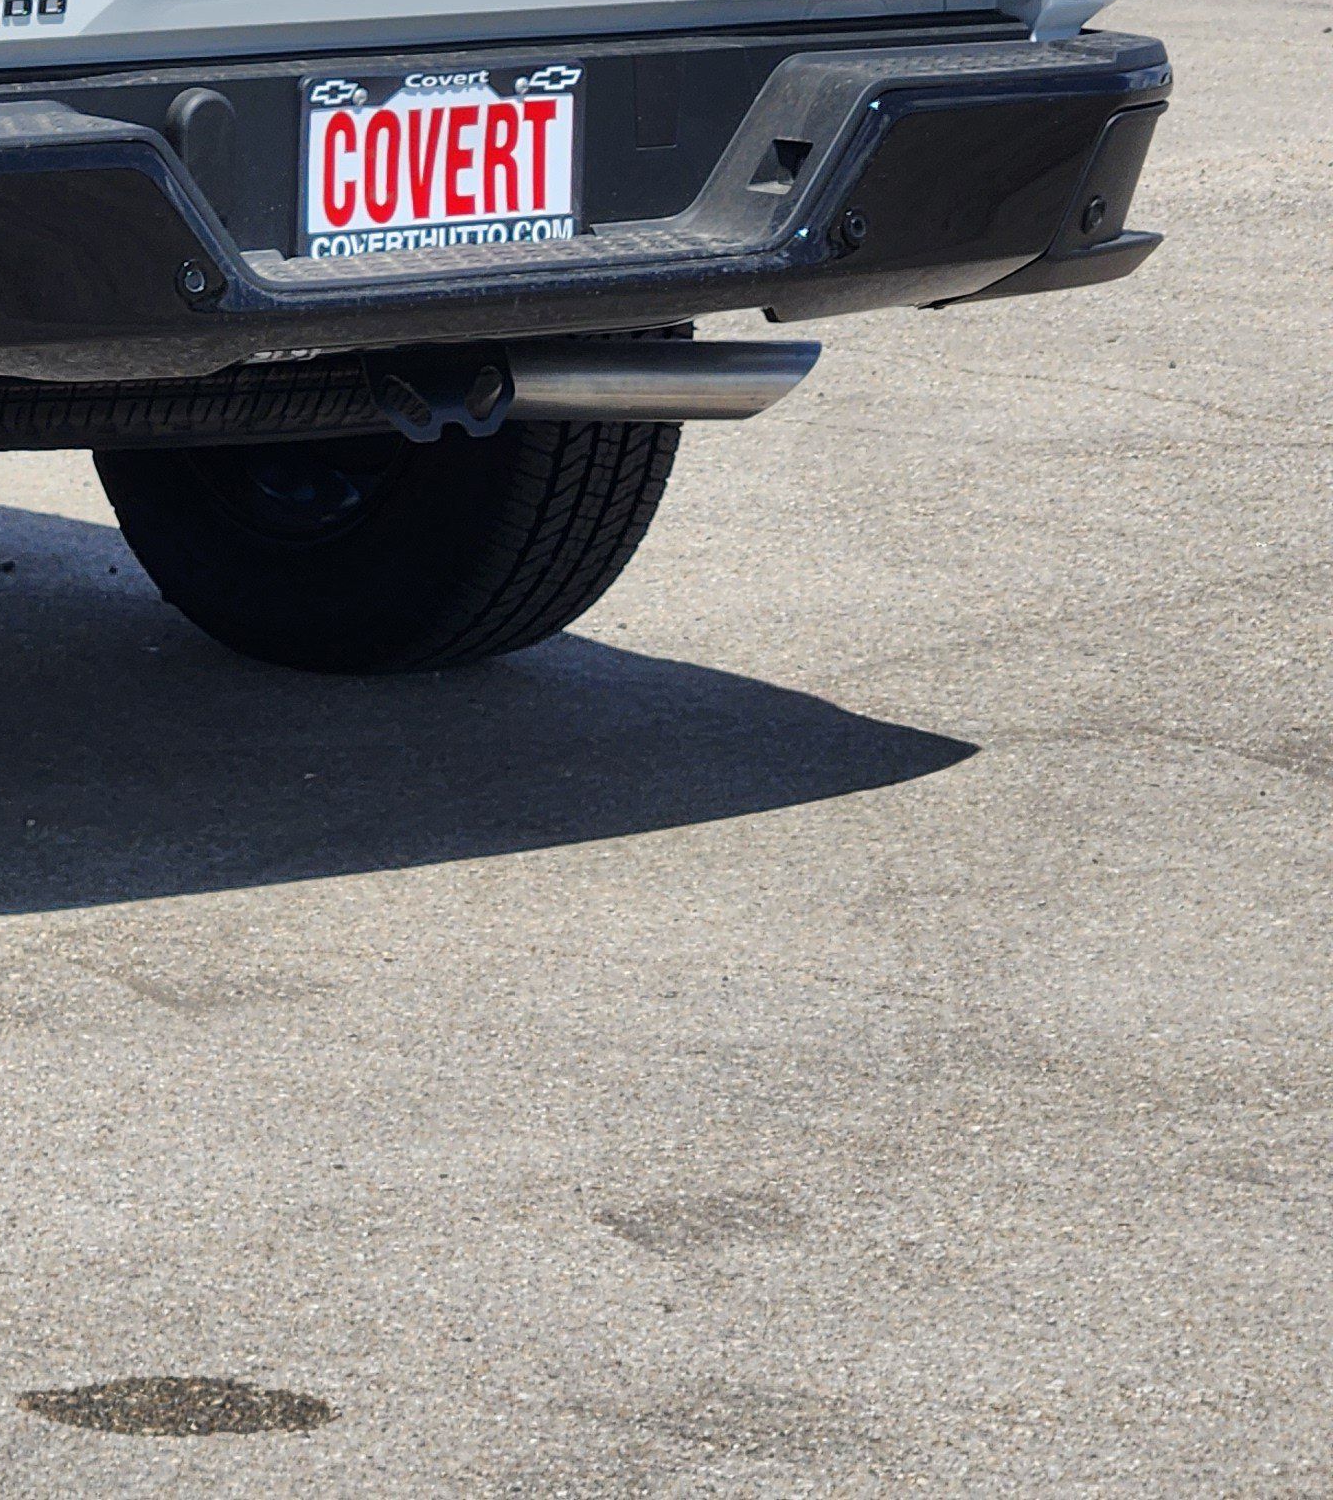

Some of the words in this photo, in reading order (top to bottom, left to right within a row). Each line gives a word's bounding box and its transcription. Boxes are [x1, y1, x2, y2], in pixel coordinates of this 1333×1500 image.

[404, 69, 490, 89] Covert
[322, 99, 558, 228] COVERT
[311, 217, 574, 260] COVERTHUTTOCOM
